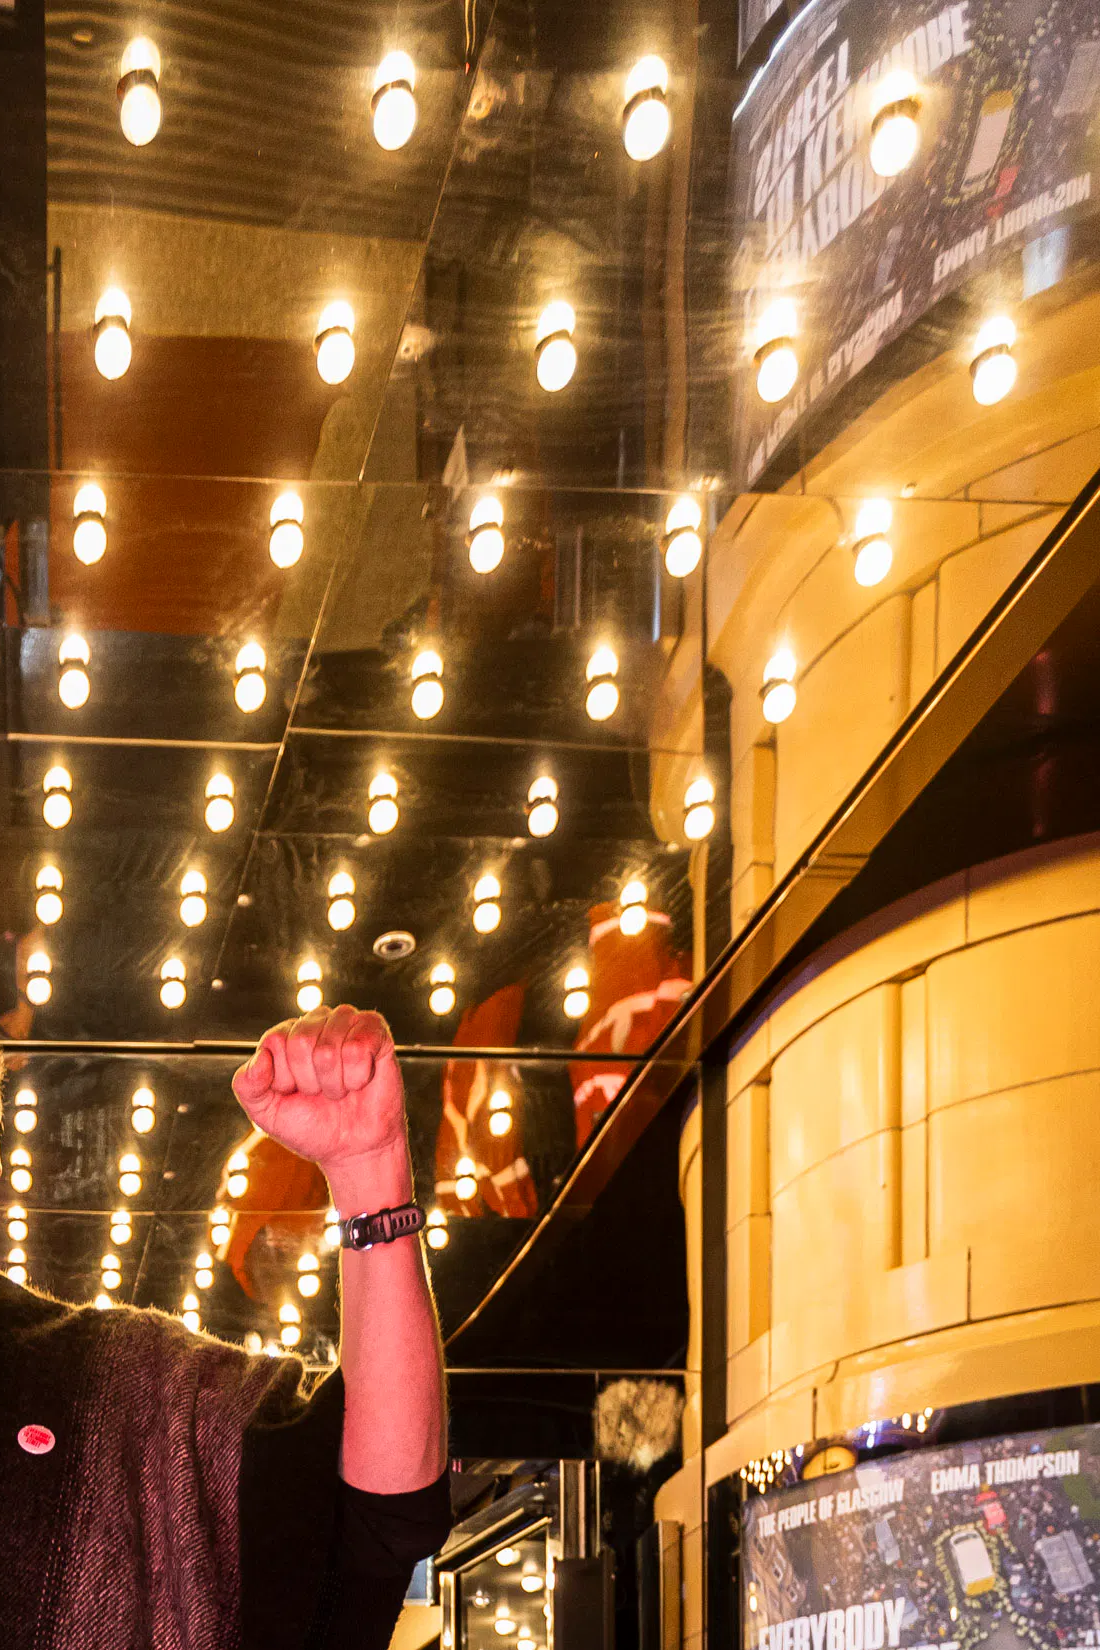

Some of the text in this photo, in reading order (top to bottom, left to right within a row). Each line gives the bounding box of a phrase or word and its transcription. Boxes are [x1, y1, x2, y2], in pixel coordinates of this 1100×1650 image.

[930, 1450, 1081, 1495] EMMA THOMPSON
[758, 1477, 905, 1538] THE PEOPLE OF GLASGOW
